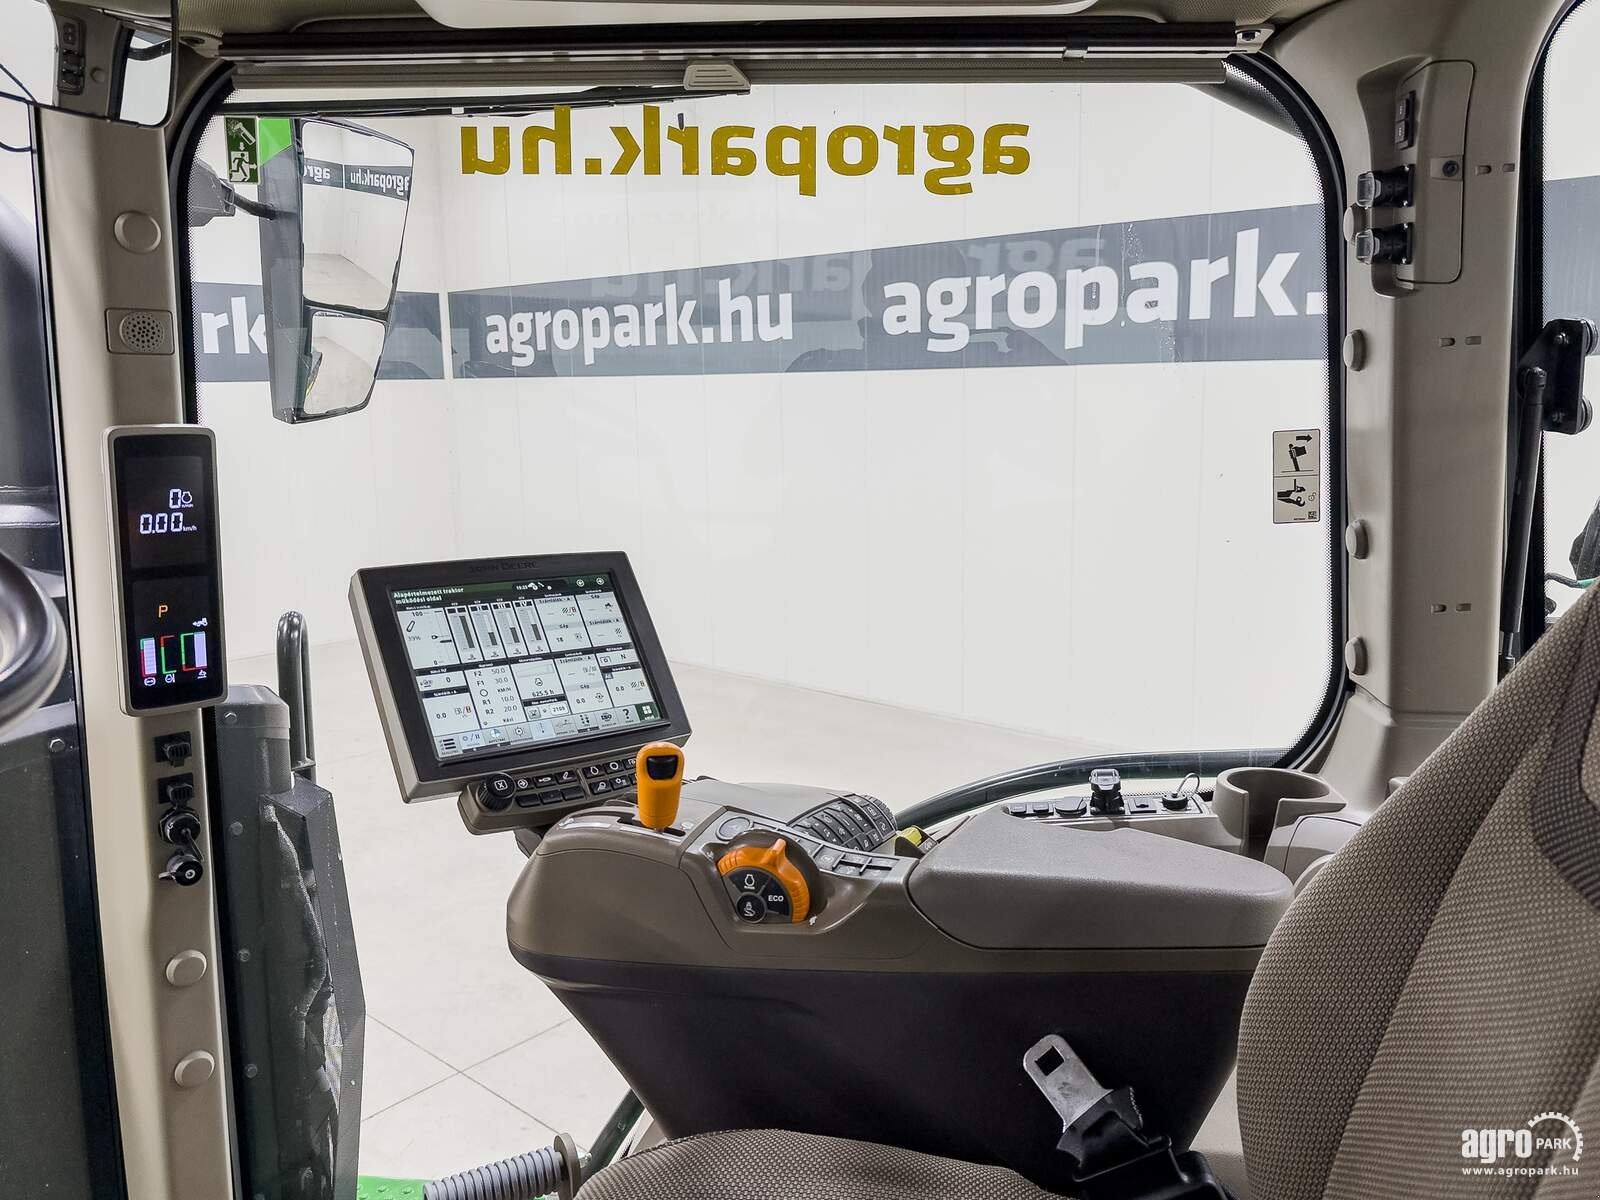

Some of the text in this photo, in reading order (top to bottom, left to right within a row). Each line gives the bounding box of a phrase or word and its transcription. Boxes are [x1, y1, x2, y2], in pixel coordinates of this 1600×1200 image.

[882, 227, 1324, 354] agropark.
[485, 278, 794, 367] agropark.hu
[169, 489, 182, 508] 0
[140, 512, 184, 534] 0.00
[158, 604, 168, 618] P
[492, 667, 505, 675] 50.0
